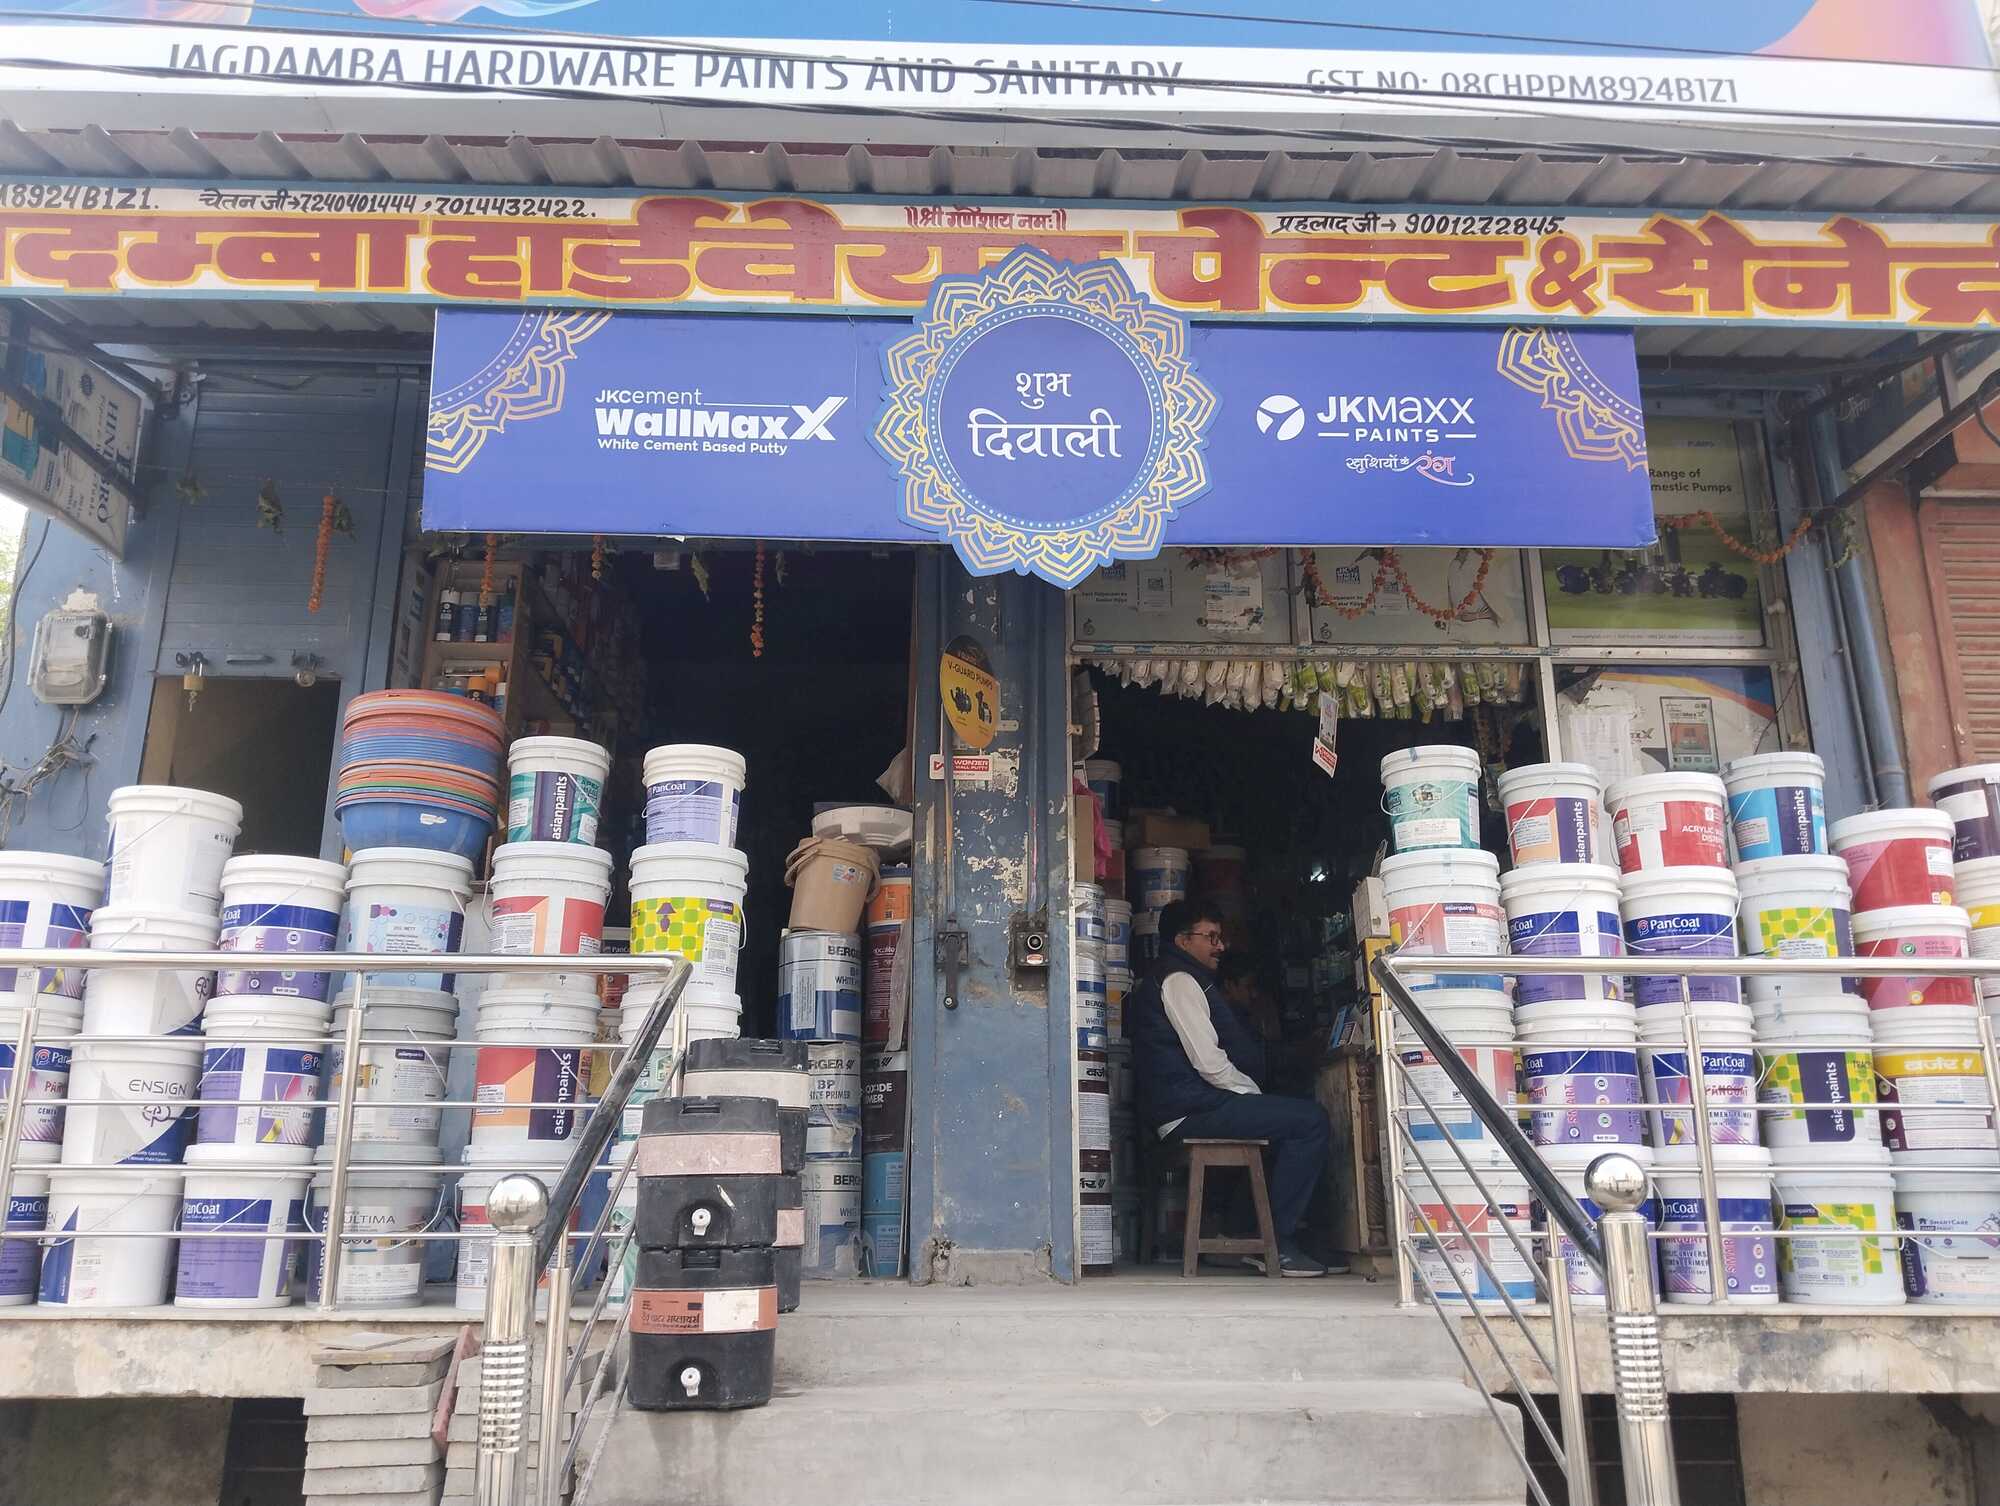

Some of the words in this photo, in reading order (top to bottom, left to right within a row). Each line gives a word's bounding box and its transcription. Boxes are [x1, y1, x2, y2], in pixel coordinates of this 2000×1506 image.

[424, 46, 675, 87] HARDWARE
[694, 53, 848, 91] PAINTS
[864, 58, 956, 94] AND
[966, 60, 1184, 97] SANITARY
[1306, 68, 1360, 92] GST
[200, 188, 261, 210] चेतन
[300, 190, 417, 214] 7240401444
[1528, 232, 1604, 318] &
[1014, 370, 1072, 409] शुभ
[967, 407, 1122, 461] दिवाली
[1354, 428, 1440, 443] PAINTS
[597, 438, 639, 451] White
[644, 440, 699, 452] Cement
[702, 441, 746, 454] Based
[750, 442, 788, 456] Putty
[1345, 454, 1399, 474] खुशियों
[1649, 468, 1686, 480] Range
[1689, 467, 1701, 478] of
[1651, 482, 1690, 492] mestic
[1692, 482, 1732, 493] Pumps
[652, 782, 687, 795] PanCoat
[551, 775, 569, 841] asianpaints
[1796, 788, 1810, 853] asianpaints
[1649, 917, 1701, 930] PanCoat
[808, 1058, 844, 1070] RGER
[1526, 1057, 1544, 1070] Coat
[1702, 1056, 1746, 1068] PanCoat
[128, 1079, 188, 1096] ENSIGN
[1709, 1111, 1732, 1119] EMENT
